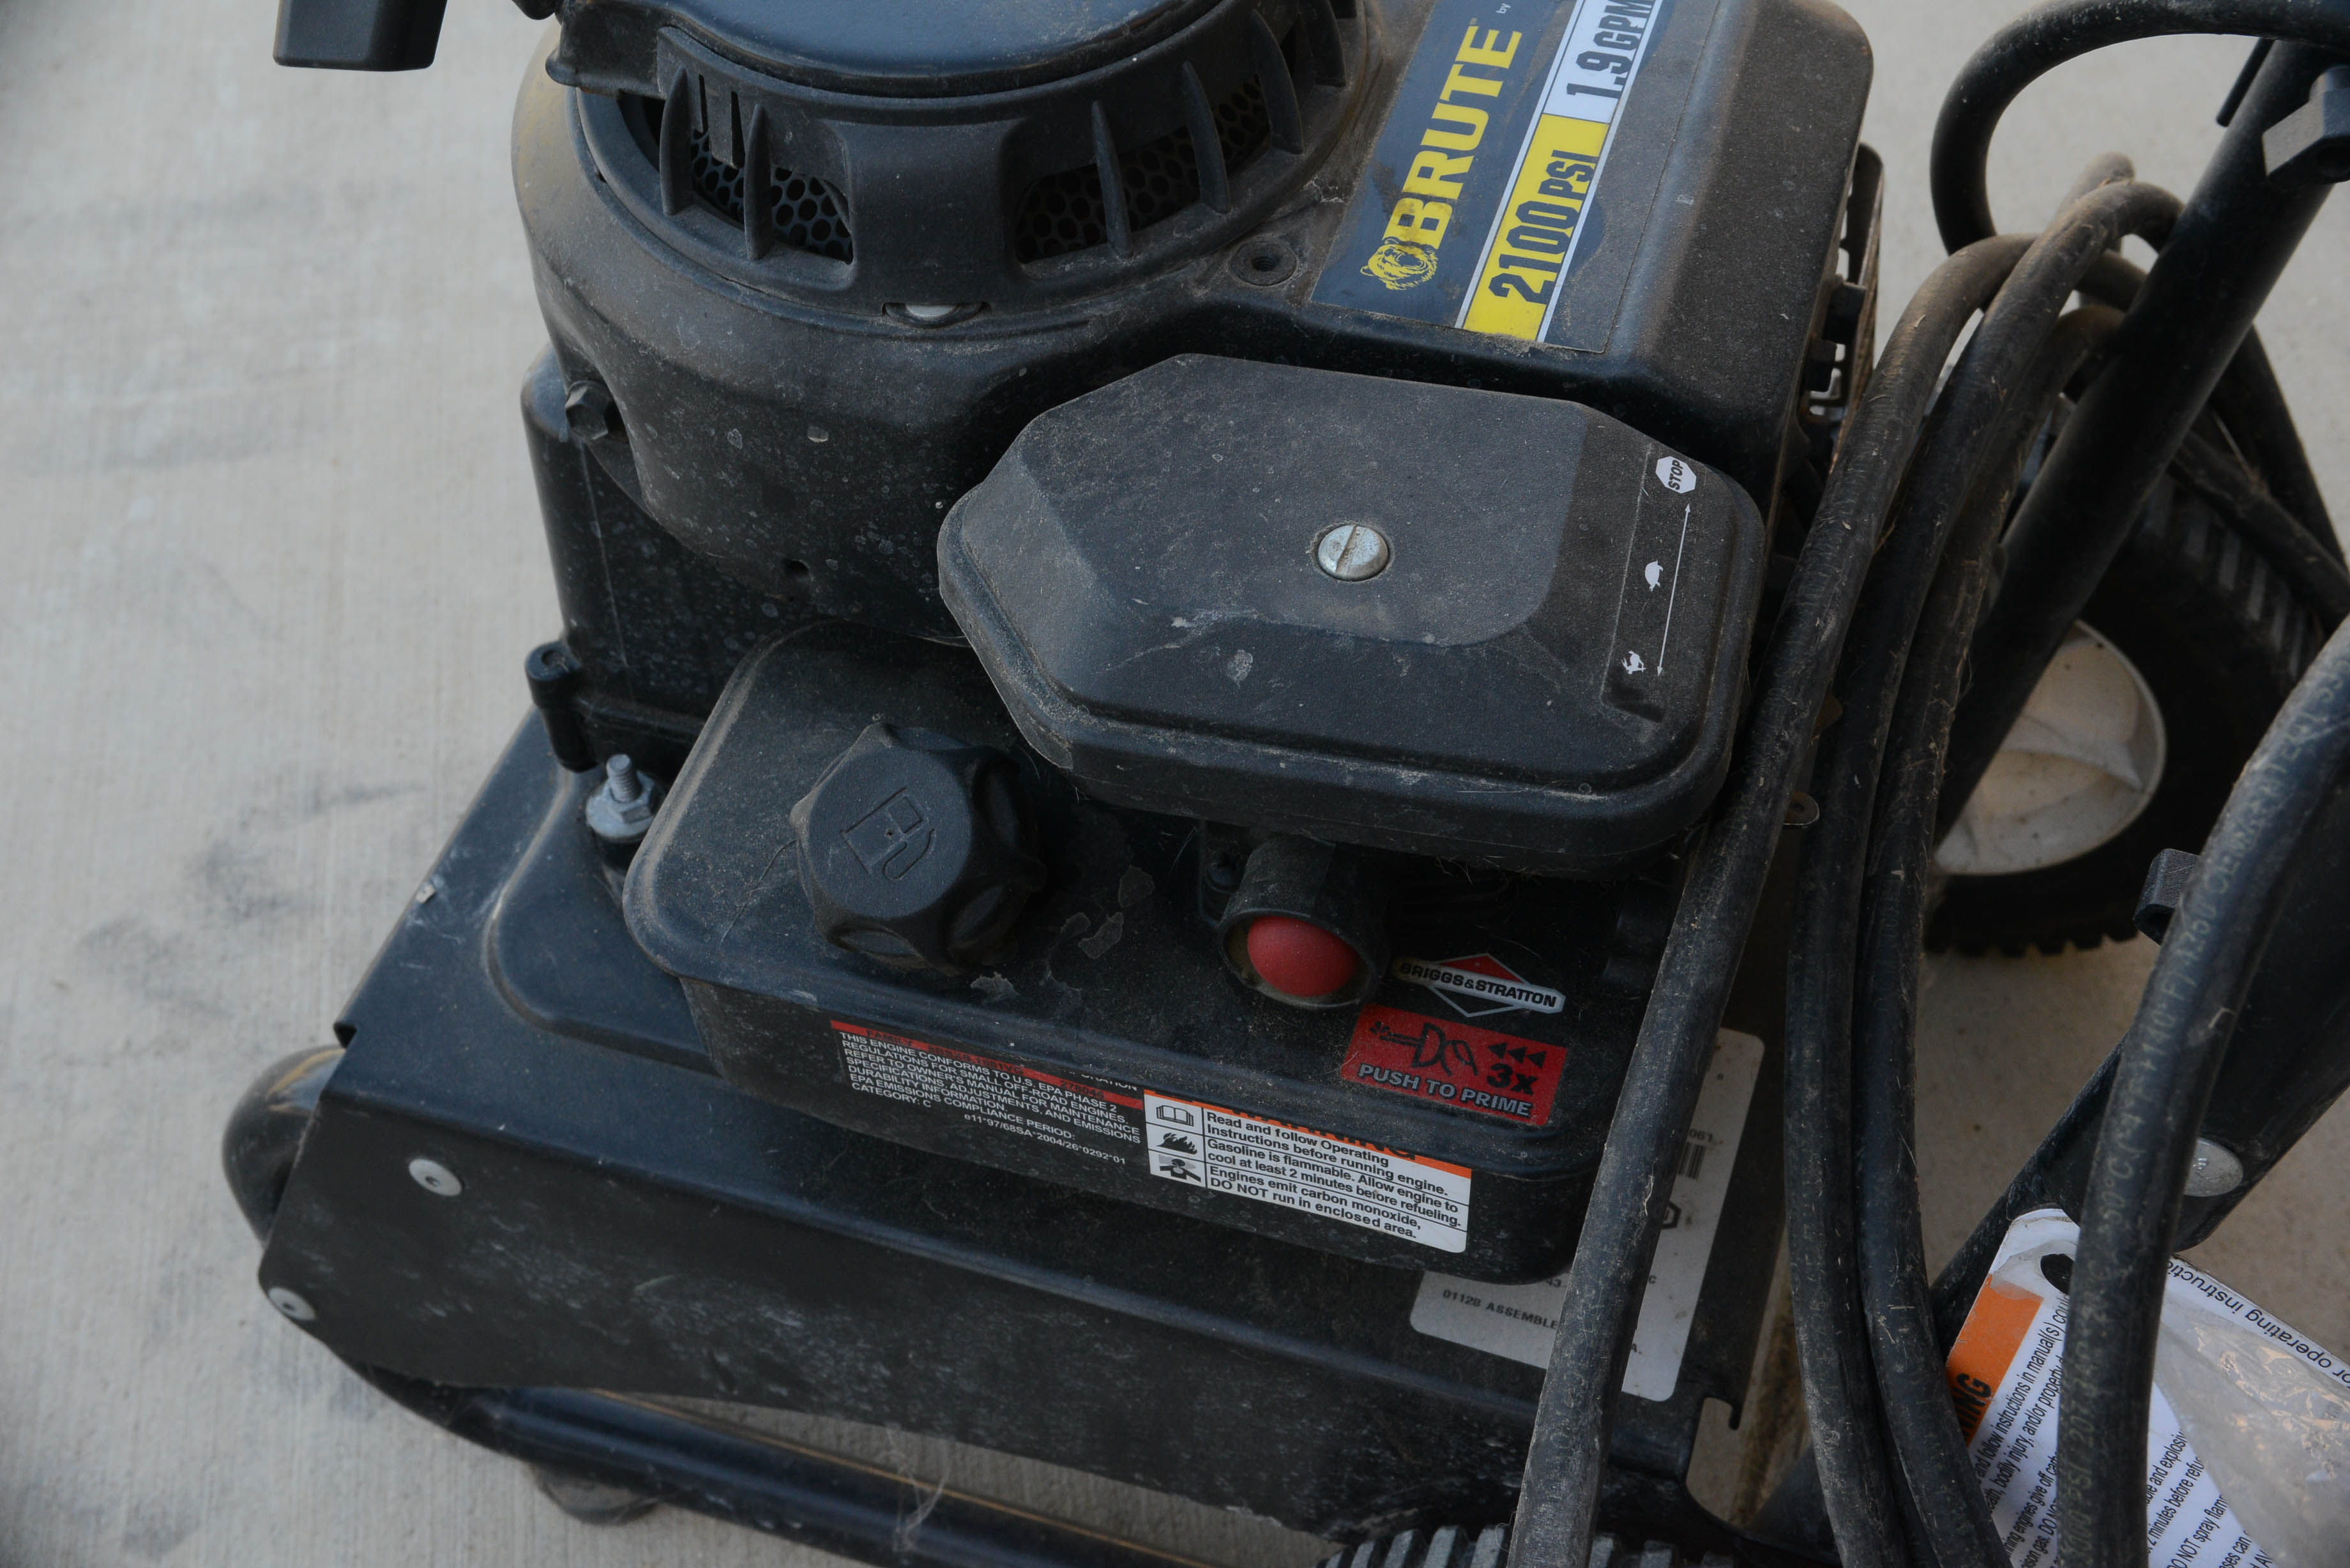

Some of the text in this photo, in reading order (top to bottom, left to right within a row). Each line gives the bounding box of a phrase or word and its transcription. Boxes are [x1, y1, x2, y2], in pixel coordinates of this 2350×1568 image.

[1383, 3, 1522, 250] BRUTE by
[1668, 459, 1684, 490] STOP
[839, 1032, 1117, 1113] THIS ENGINE CONFORMS TO U.S. EPA PHASE 2
[842, 1037, 1128, 1124] REGULATIONS FOR SMALL OFF-ROAD ENGINES.
[844, 1048, 1140, 1136] REFER TO OWNER'S MANUAL FOR MAINTENANCE
[845, 1053, 1141, 1143] SPECIFICATIONS, ADJUSTMENTS, AND EMISSIONS
[848, 1062, 1008, 1112] DURABILITY INFORMATION.
[851, 1080, 932, 1108] CATEGORY: C
[1358, 1062, 1533, 1119] PUSH TO PRIME
[850, 1073, 1075, 1140] EPA EMISSIONS COMPLIANCE PERIOD:
[1206, 1111, 1389, 1168] Read and follow Operating
[1207, 1123, 1290, 1151] Instructions
[1293, 1143, 1337, 1163] before
[1340, 1157, 1394, 1181] running
[1397, 1174, 1448, 1196] engine.
[1206, 1136, 1459, 1213] Gasoline is flammable. Allow engine to
[1208, 1152, 1461, 1227] cool at least 2 minutes before refueling.
[1209, 1165, 1423, 1230] Engines emit carbon monoxide,
[1210, 1177, 1416, 1239] DO NOT run in enclosed area.
[1443, 1288, 1482, 1308] 01128
[2027, 1322, 2066, 1373] manual(s)
[2245, 1309, 2331, 1369] operating
[2017, 1371, 2036, 1385] in
[1991, 1382, 2031, 1435] instructions
[2022, 1403, 2047, 1436] and/or
[1978, 1431, 2005, 1461] follow
[1990, 1459, 2020, 1488] bodily
[2004, 1434, 2035, 1463] injury,
[2013, 1502, 2038, 1534] engines
[2028, 1486, 2047, 1507] give
[2038, 1470, 2054, 1488] off
[2149, 1465, 2168, 1487] and
[2038, 1518, 2058, 1536] DO
[2148, 1504, 2177, 1540] minutes
[2164, 1479, 2194, 1509] before
[2176, 1537, 2202, 1564] NOT
[2193, 1516, 2220, 1543] spray
[2232, 1536, 2253, 1555] can
